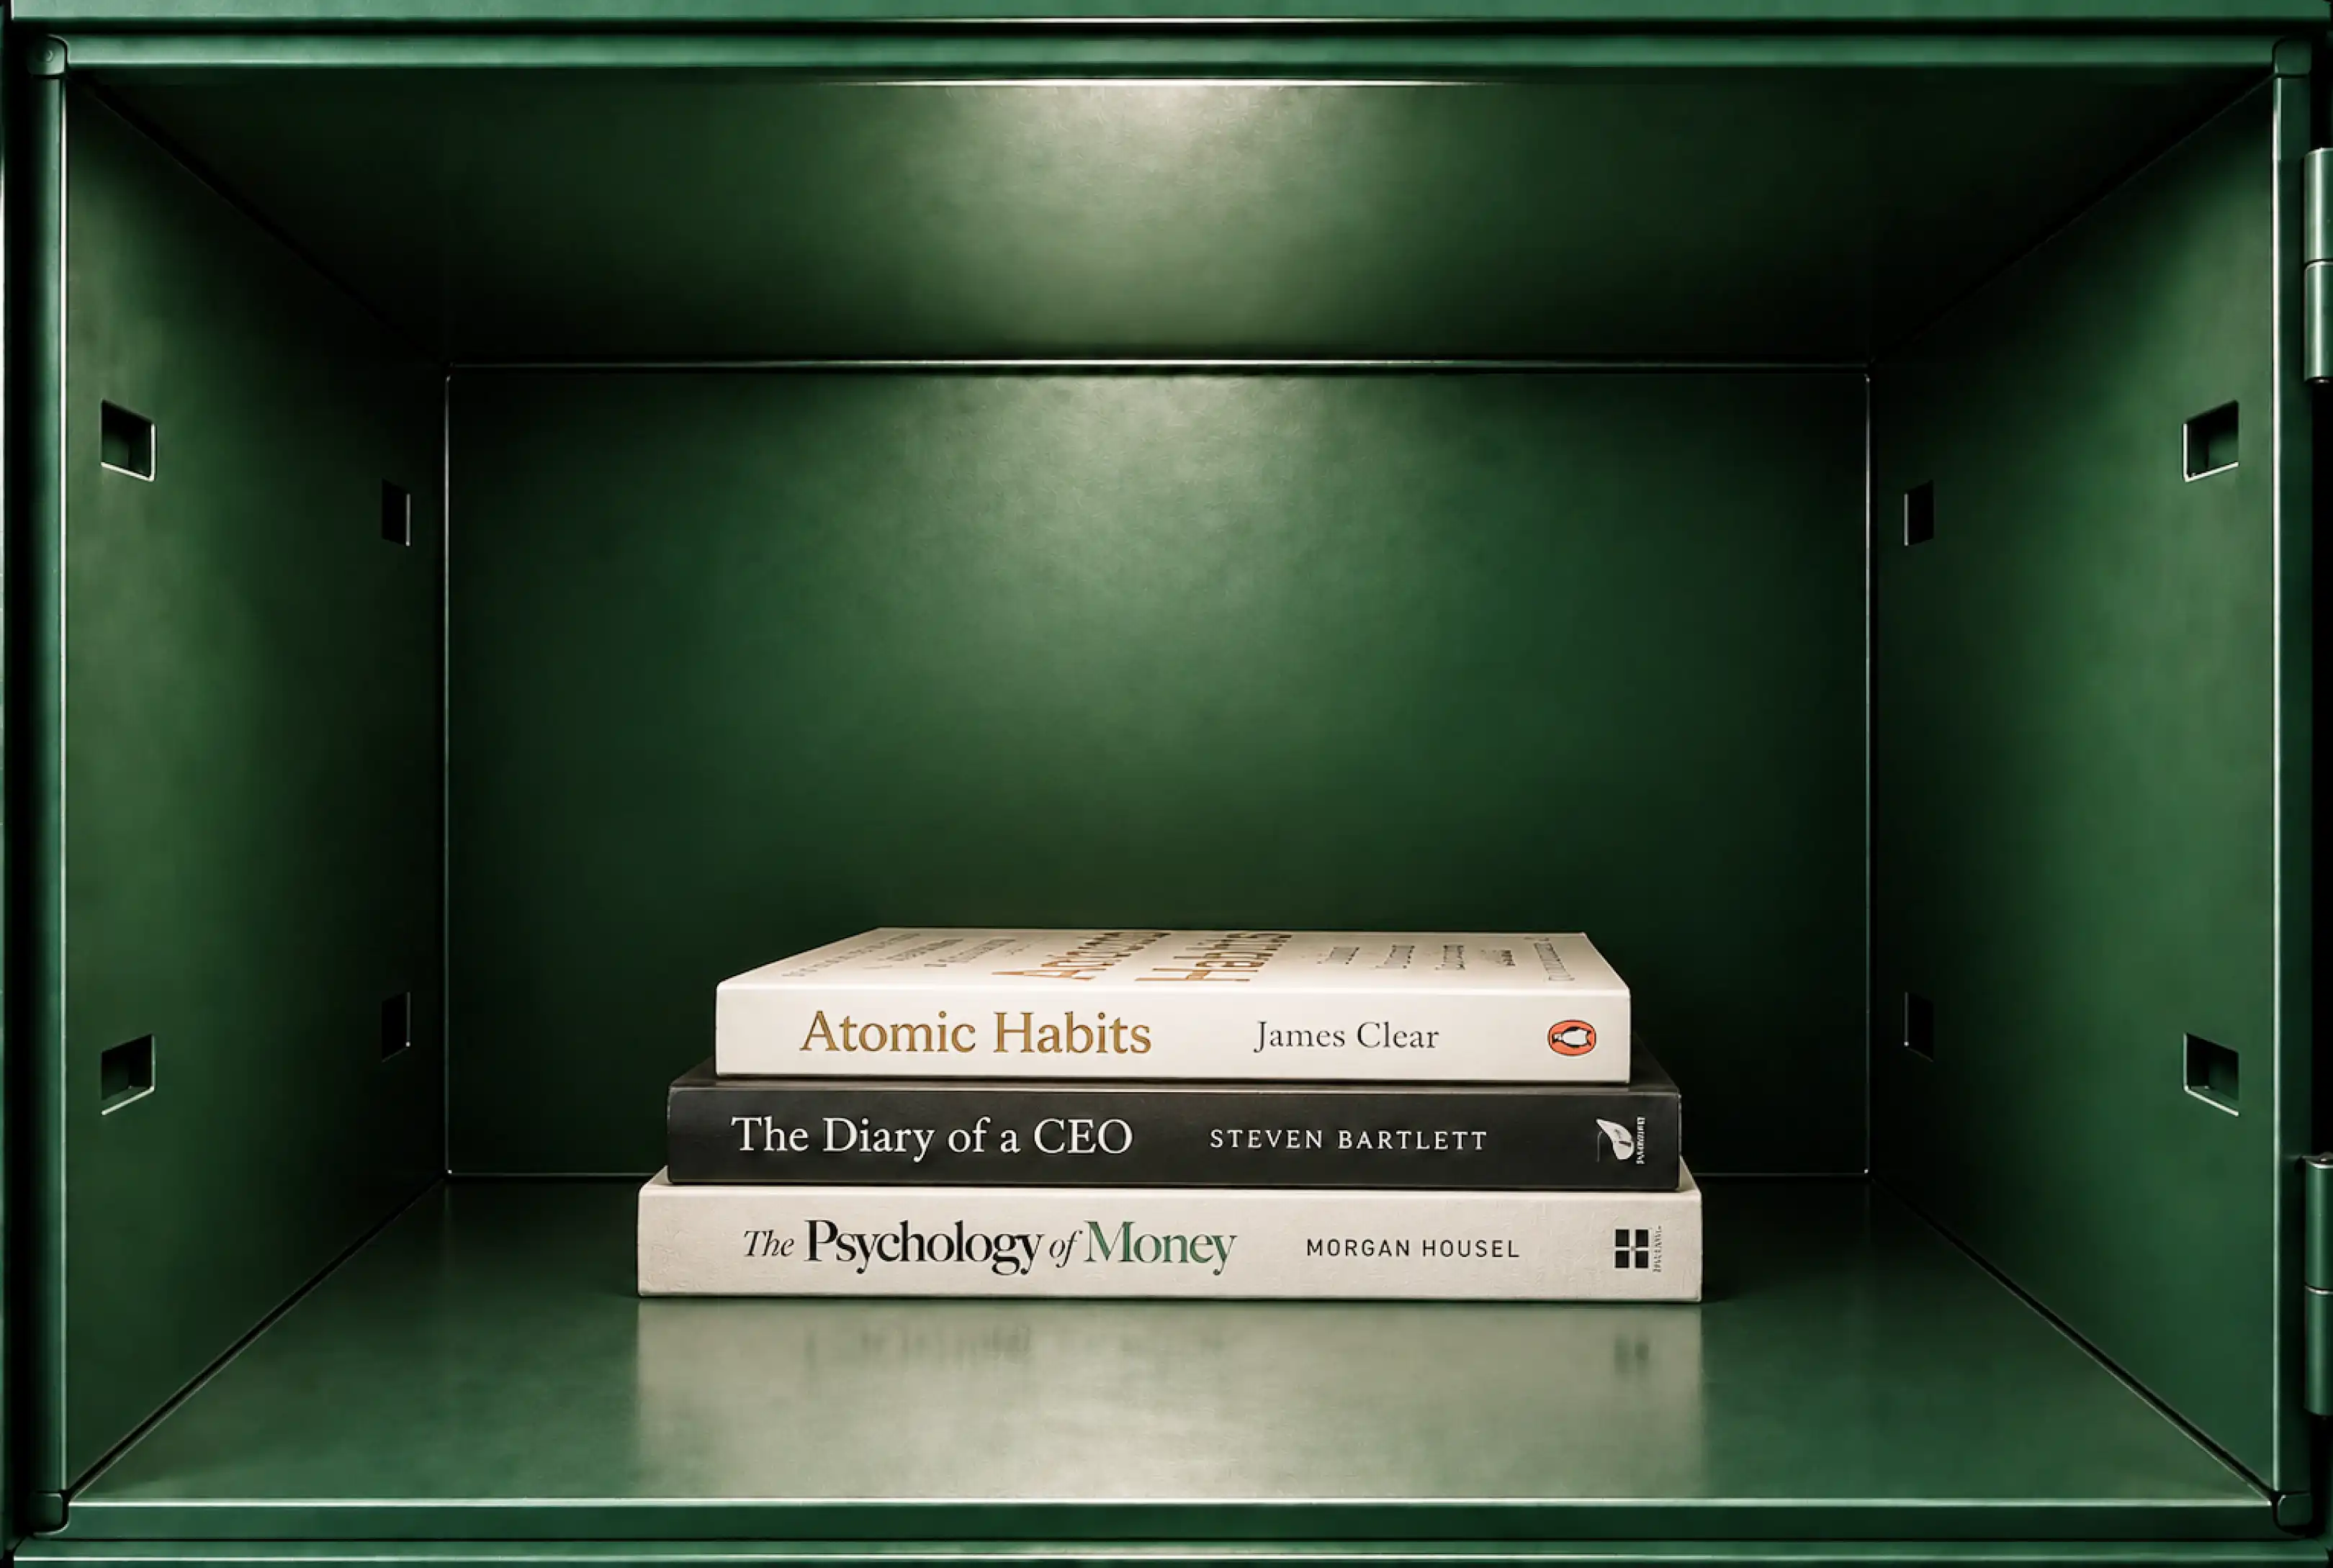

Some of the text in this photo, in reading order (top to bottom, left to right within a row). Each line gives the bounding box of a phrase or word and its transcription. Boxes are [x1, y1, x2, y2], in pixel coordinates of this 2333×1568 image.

[799, 1009, 1152, 1055] Atomic Habits
[1253, 1020, 1440, 1053] James Clear
[729, 1114, 1133, 1163] The Diary of a CEO
[1209, 1127, 1488, 1150] STEVEN BARTLETT
[743, 1219, 1239, 1276] The Psychology of Money
[1306, 1238, 1521, 1258] MORGAN HOUSEL
